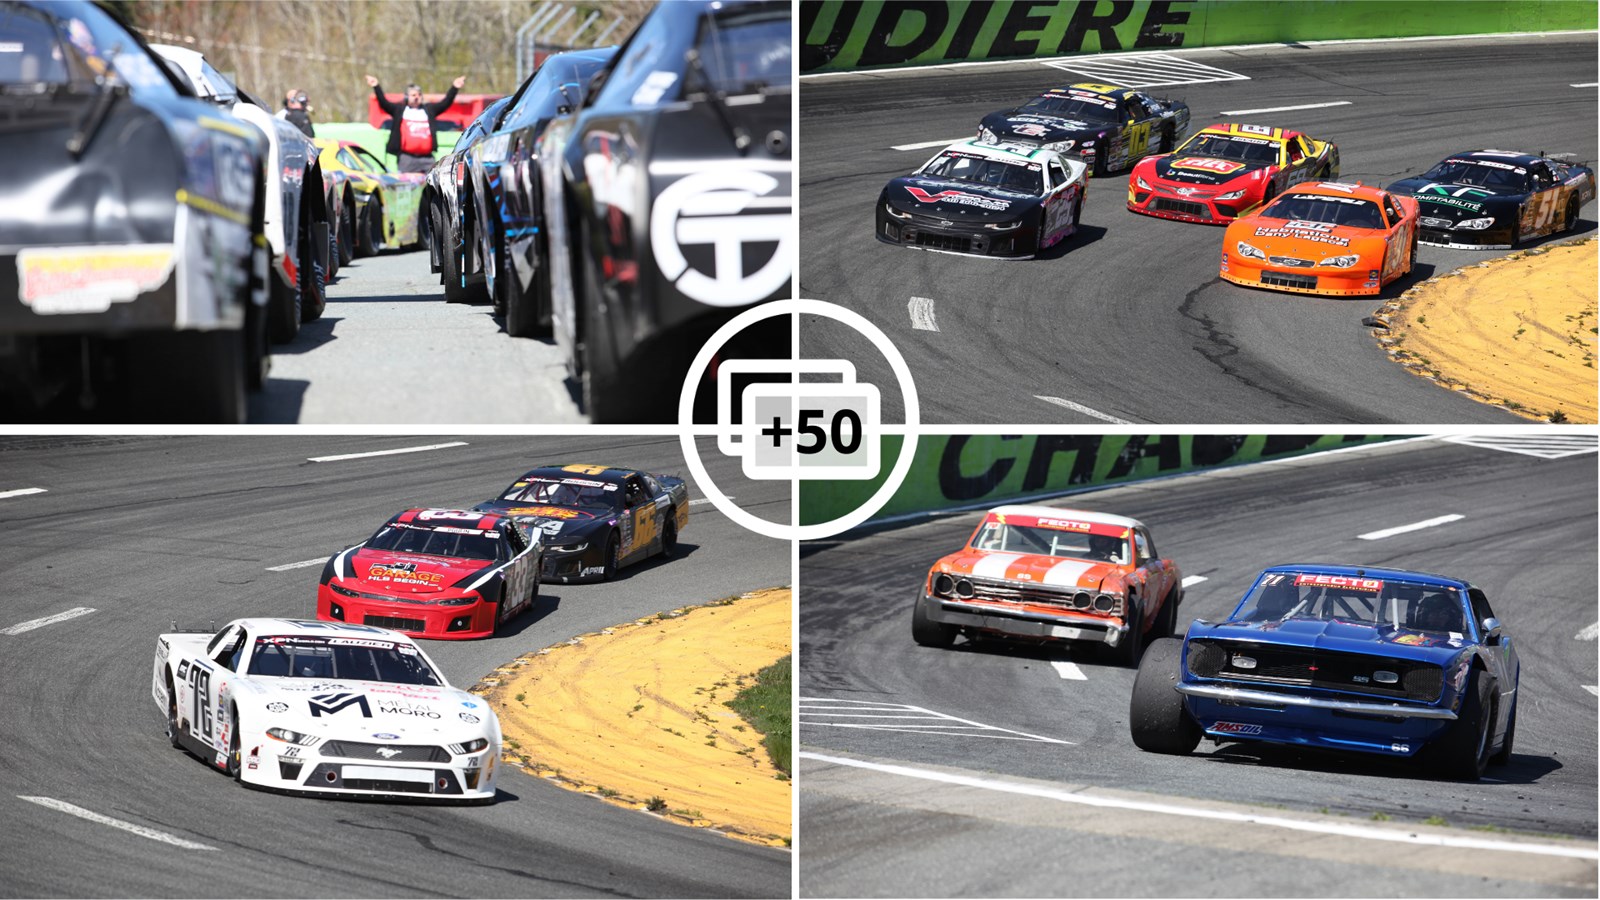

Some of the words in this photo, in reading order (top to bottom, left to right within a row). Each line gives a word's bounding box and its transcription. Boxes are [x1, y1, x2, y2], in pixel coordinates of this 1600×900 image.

[1412, 194, 1482, 212] OMPTABILITÉ
[371, 567, 442, 583] GARAGE
[1300, 574, 1379, 589] FECTO
[332, 638, 392, 649] LAUZIER
[380, 706, 441, 720] MORO
[1208, 720, 1263, 735] AMSOIL
